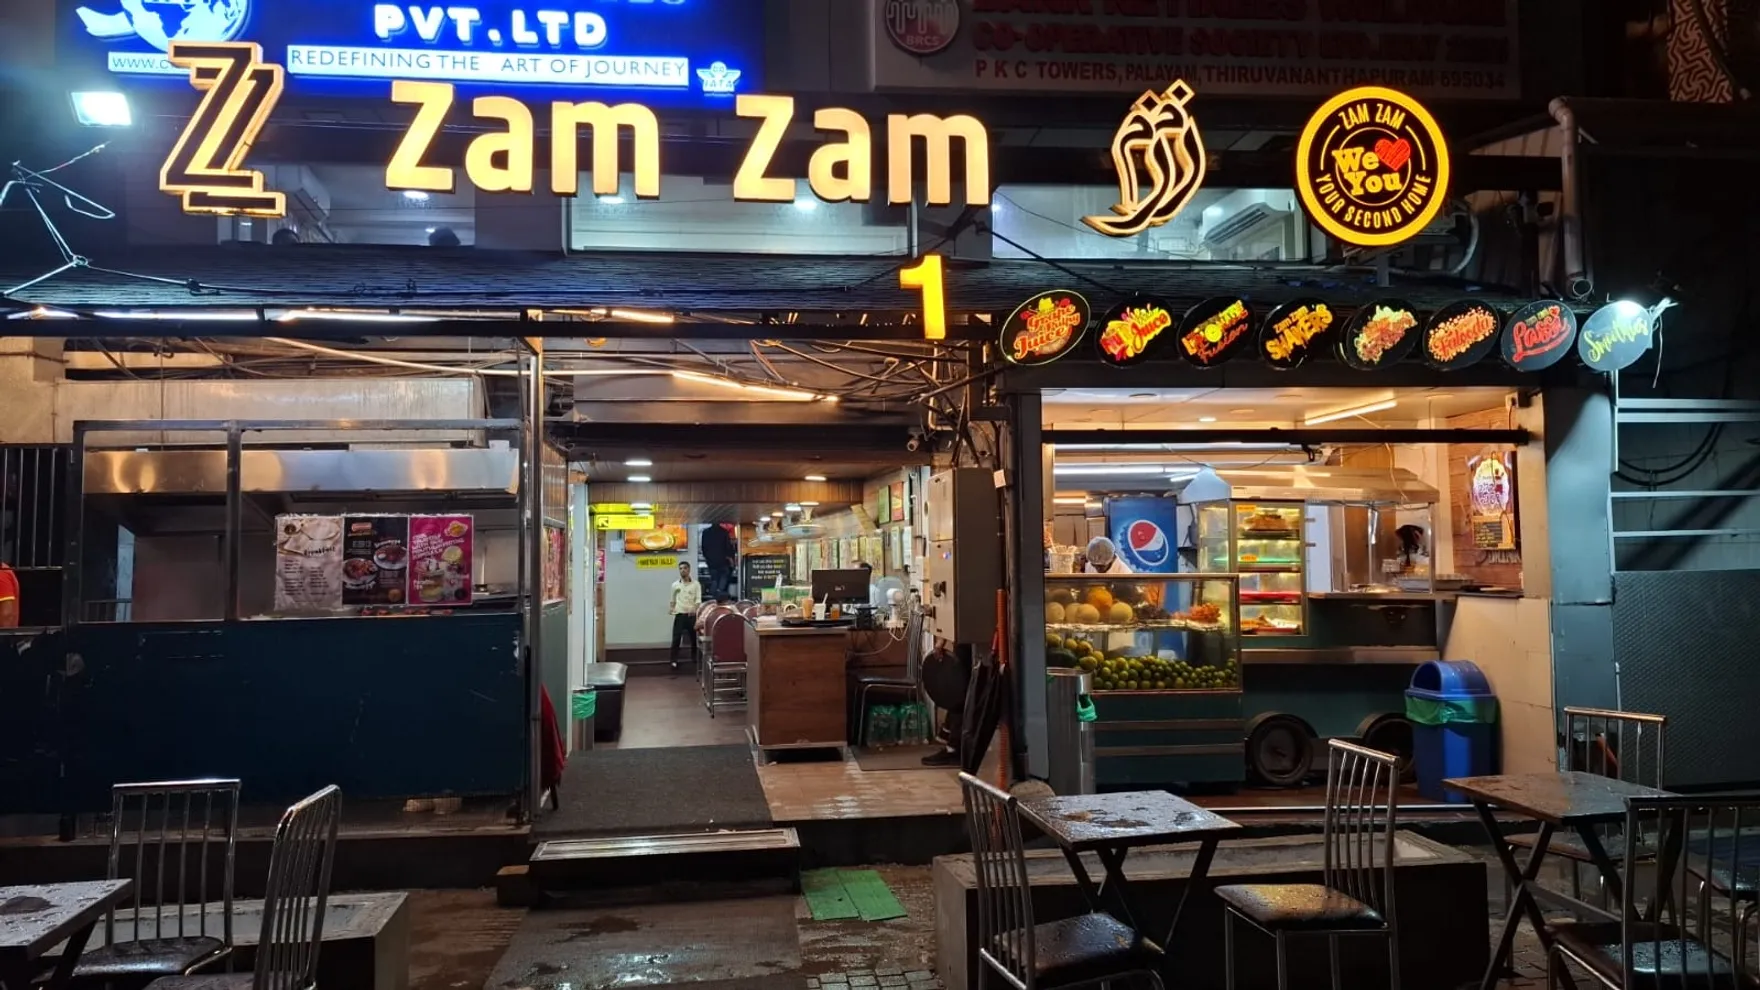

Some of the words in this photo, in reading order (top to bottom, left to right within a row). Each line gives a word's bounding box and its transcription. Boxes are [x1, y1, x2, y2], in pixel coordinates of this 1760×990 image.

[906, 34, 941, 46] BRCS
[291, 49, 431, 69] REDEFINING
[436, 54, 480, 71] THE
[500, 57, 542, 74] ART
[550, 58, 578, 75] OF
[584, 60, 685, 78] JOURNEY
[975, 59, 988, 77] P
[995, 60, 1008, 78] K
[1015, 61, 1027, 78] C
[1035, 61, 1122, 83] TOWERS,
[1338, 103, 1370, 130] ZAM
[1375, 103, 1406, 130] ZAM
[385, 80, 661, 200] Zam
[733, 94, 990, 207] Zam
[1331, 147, 1380, 174] We
[1343, 171, 1403, 196] You
[1315, 173, 1346, 214] YOUR
[1343, 206, 1403, 229] SECOND
[1400, 174, 1432, 215] HOME
[900, 255, 946, 340] 1
[1013, 324, 1070, 360] Juice
